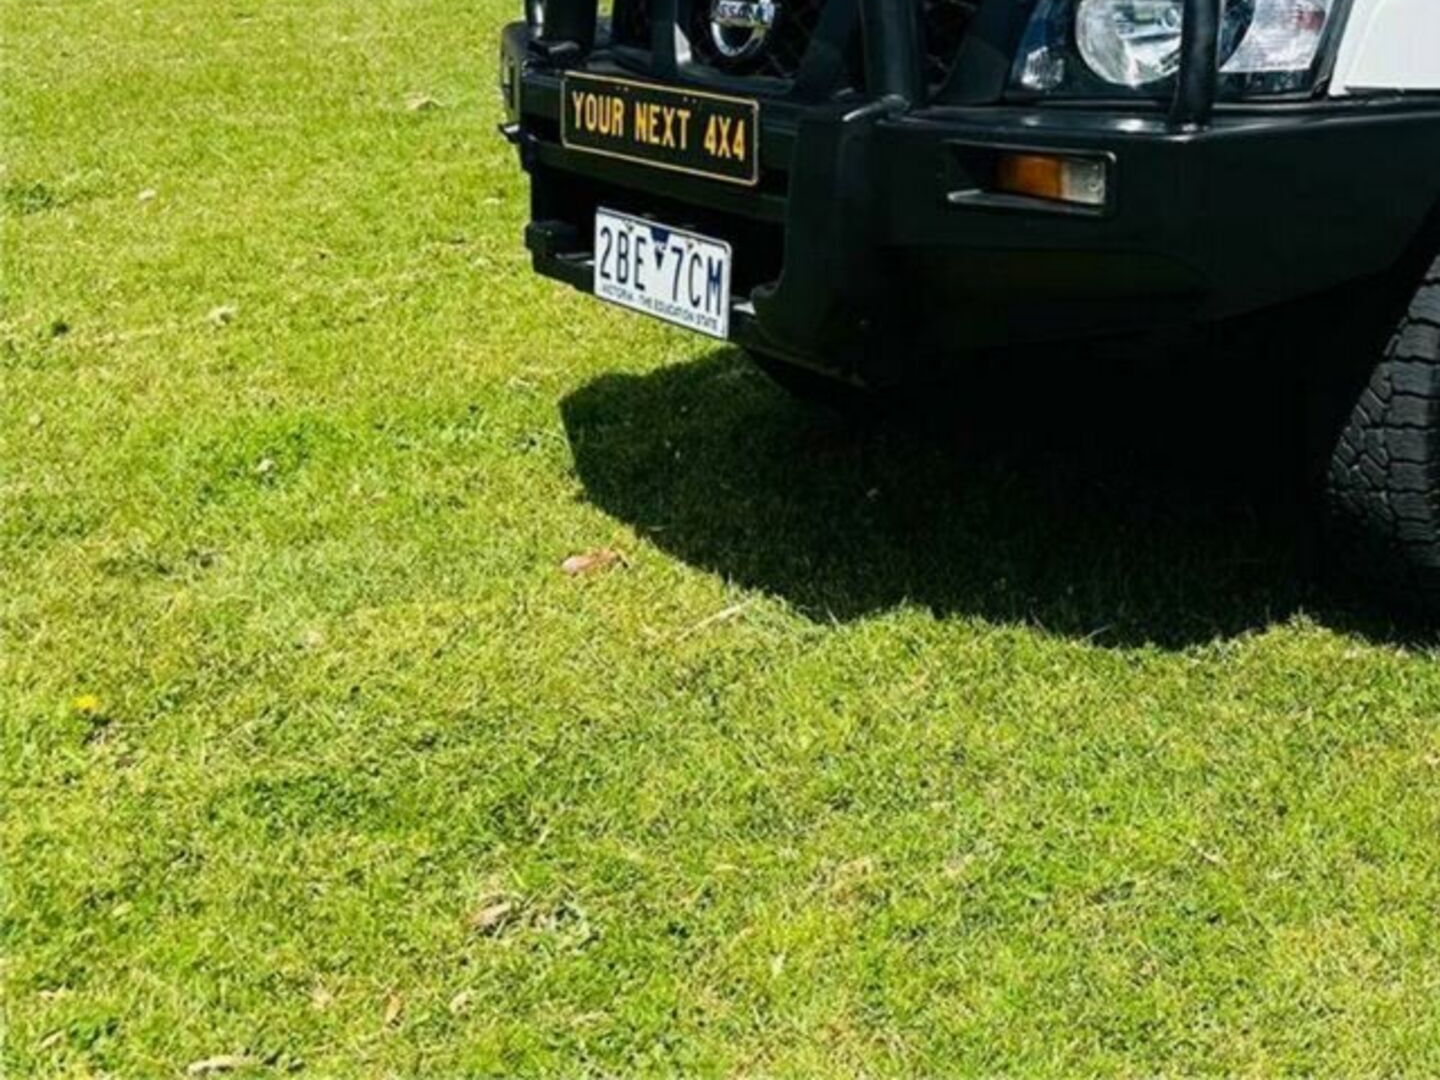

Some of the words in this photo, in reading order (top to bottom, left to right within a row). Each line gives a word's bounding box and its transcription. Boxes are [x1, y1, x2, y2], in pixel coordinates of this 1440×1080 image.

[572, 90, 624, 138] YOUR
[634, 101, 692, 151] NEXT
[704, 114, 746, 162] 4X4
